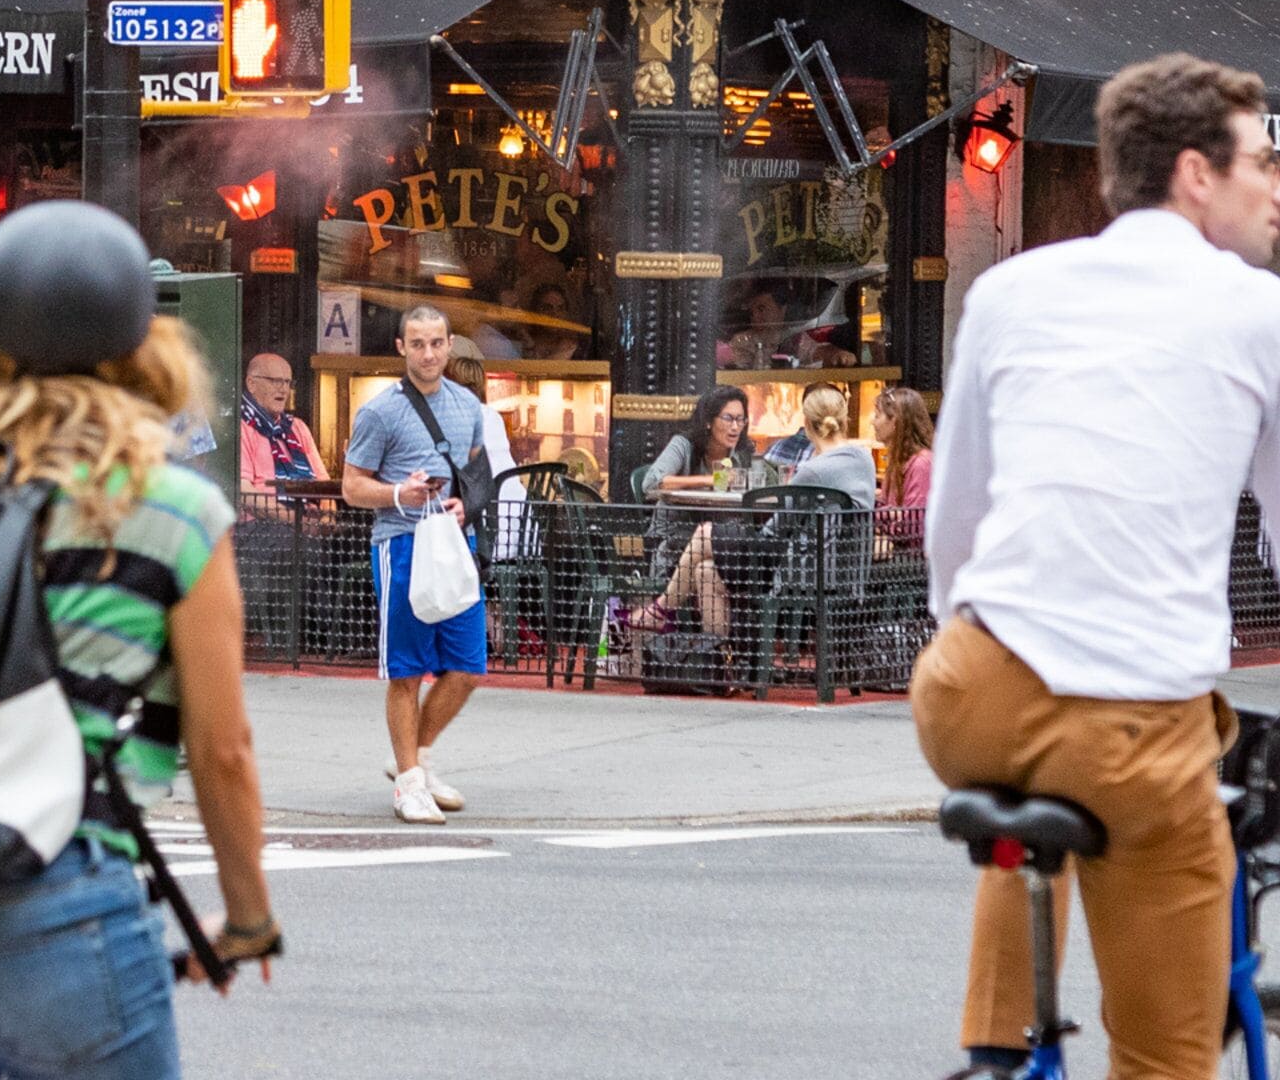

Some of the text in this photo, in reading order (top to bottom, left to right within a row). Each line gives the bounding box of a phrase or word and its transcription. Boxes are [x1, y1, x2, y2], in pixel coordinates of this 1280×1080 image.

[114, 7, 147, 17] Zone#
[114, 19, 206, 40] 105132
[353, 168, 579, 255] PETE'S
[323, 302, 350, 338] A
